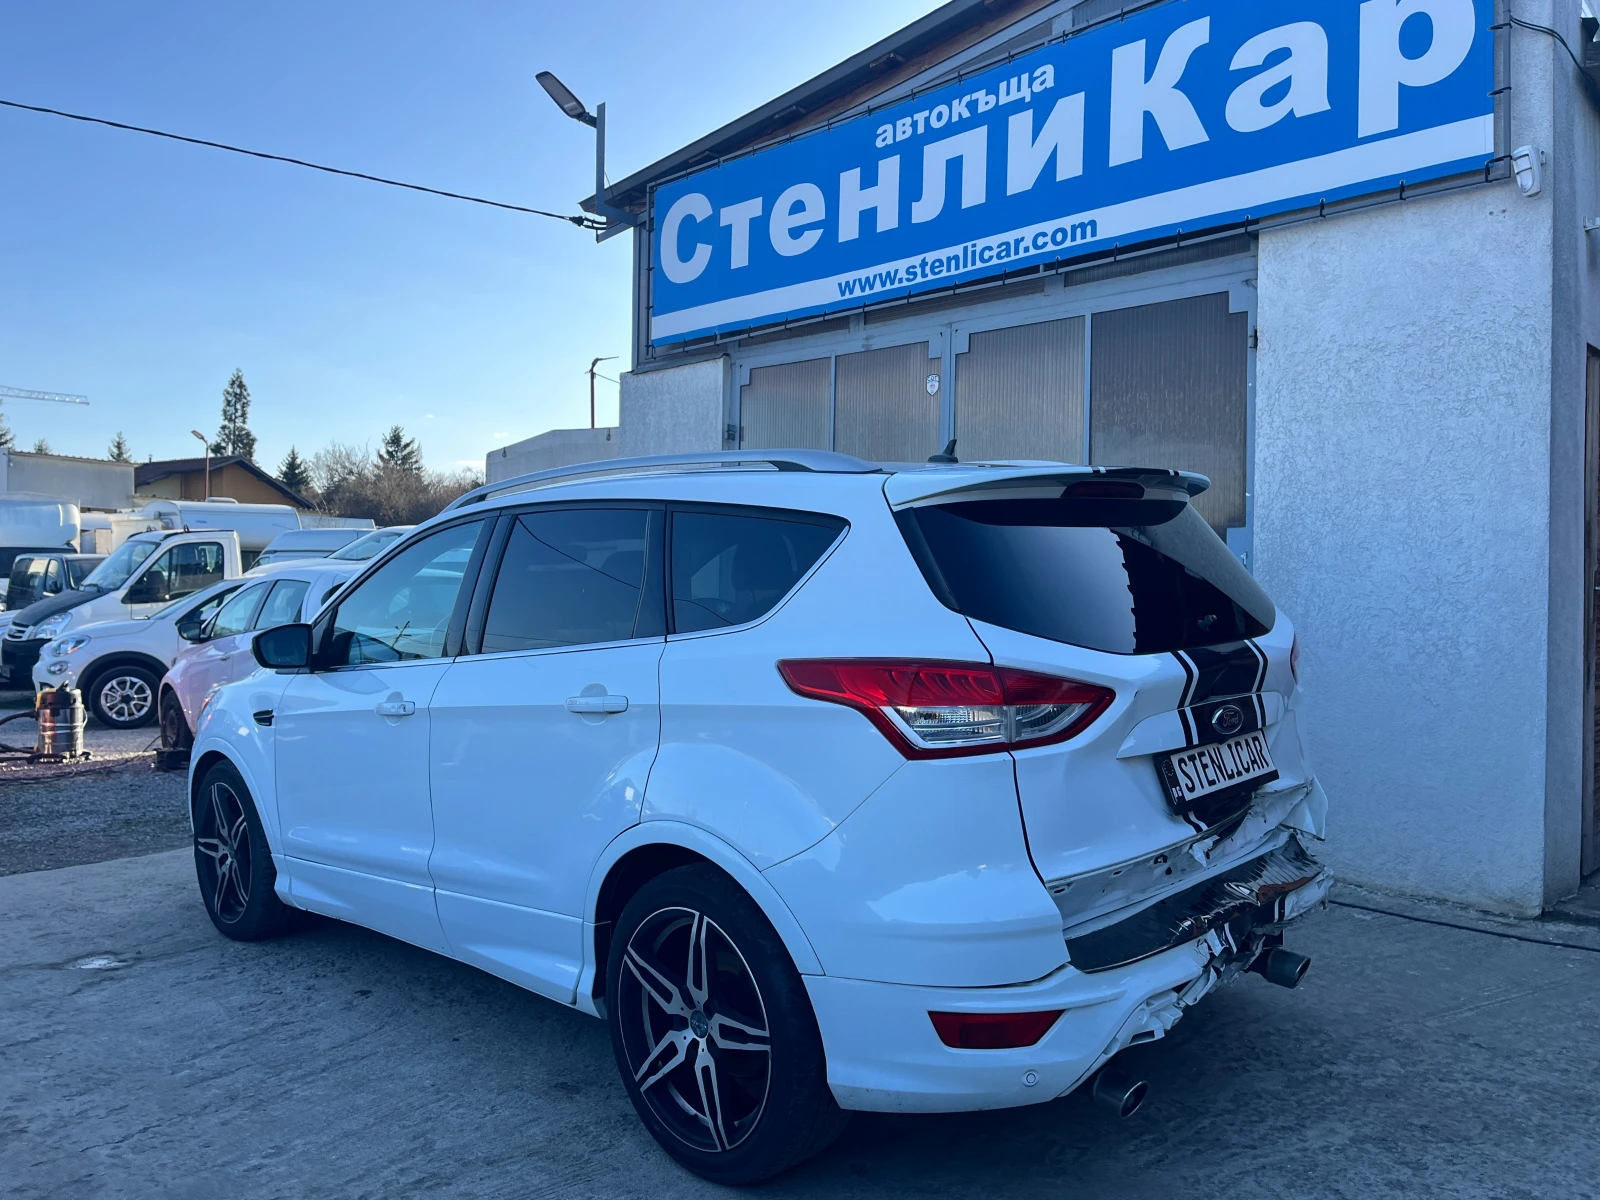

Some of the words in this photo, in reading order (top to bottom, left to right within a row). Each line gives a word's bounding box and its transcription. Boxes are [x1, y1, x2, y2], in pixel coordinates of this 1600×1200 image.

[660, 0, 1476, 284] СтенлиКар
[875, 64, 1055, 148] автокъща
[837, 218, 1099, 299] www.stenlicar.com
[1177, 735, 1270, 794] STENLICAR
